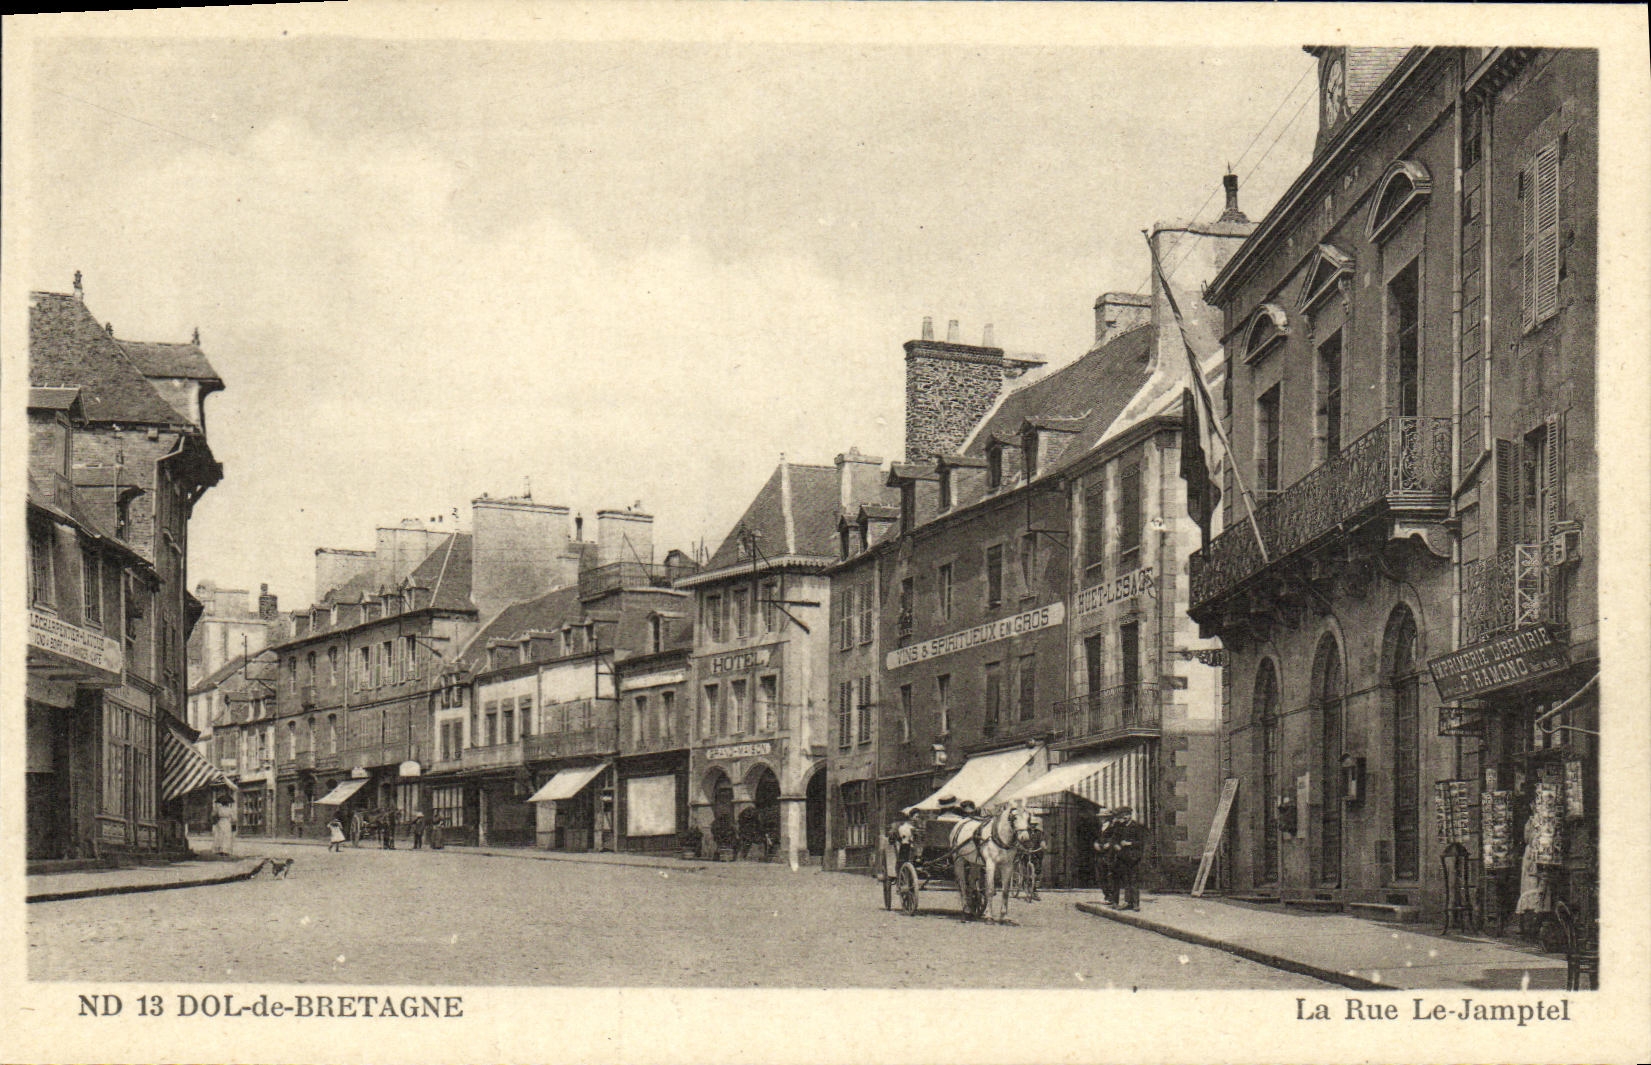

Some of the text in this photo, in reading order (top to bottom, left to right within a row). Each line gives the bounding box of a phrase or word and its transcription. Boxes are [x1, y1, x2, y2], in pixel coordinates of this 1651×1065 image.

[896, 608, 1050, 665] VINS & SPIRITUEUX EN GROS
[1431, 647, 1490, 680] IMPRIMERIE
[1489, 627, 1551, 661] LIBRAIRIE
